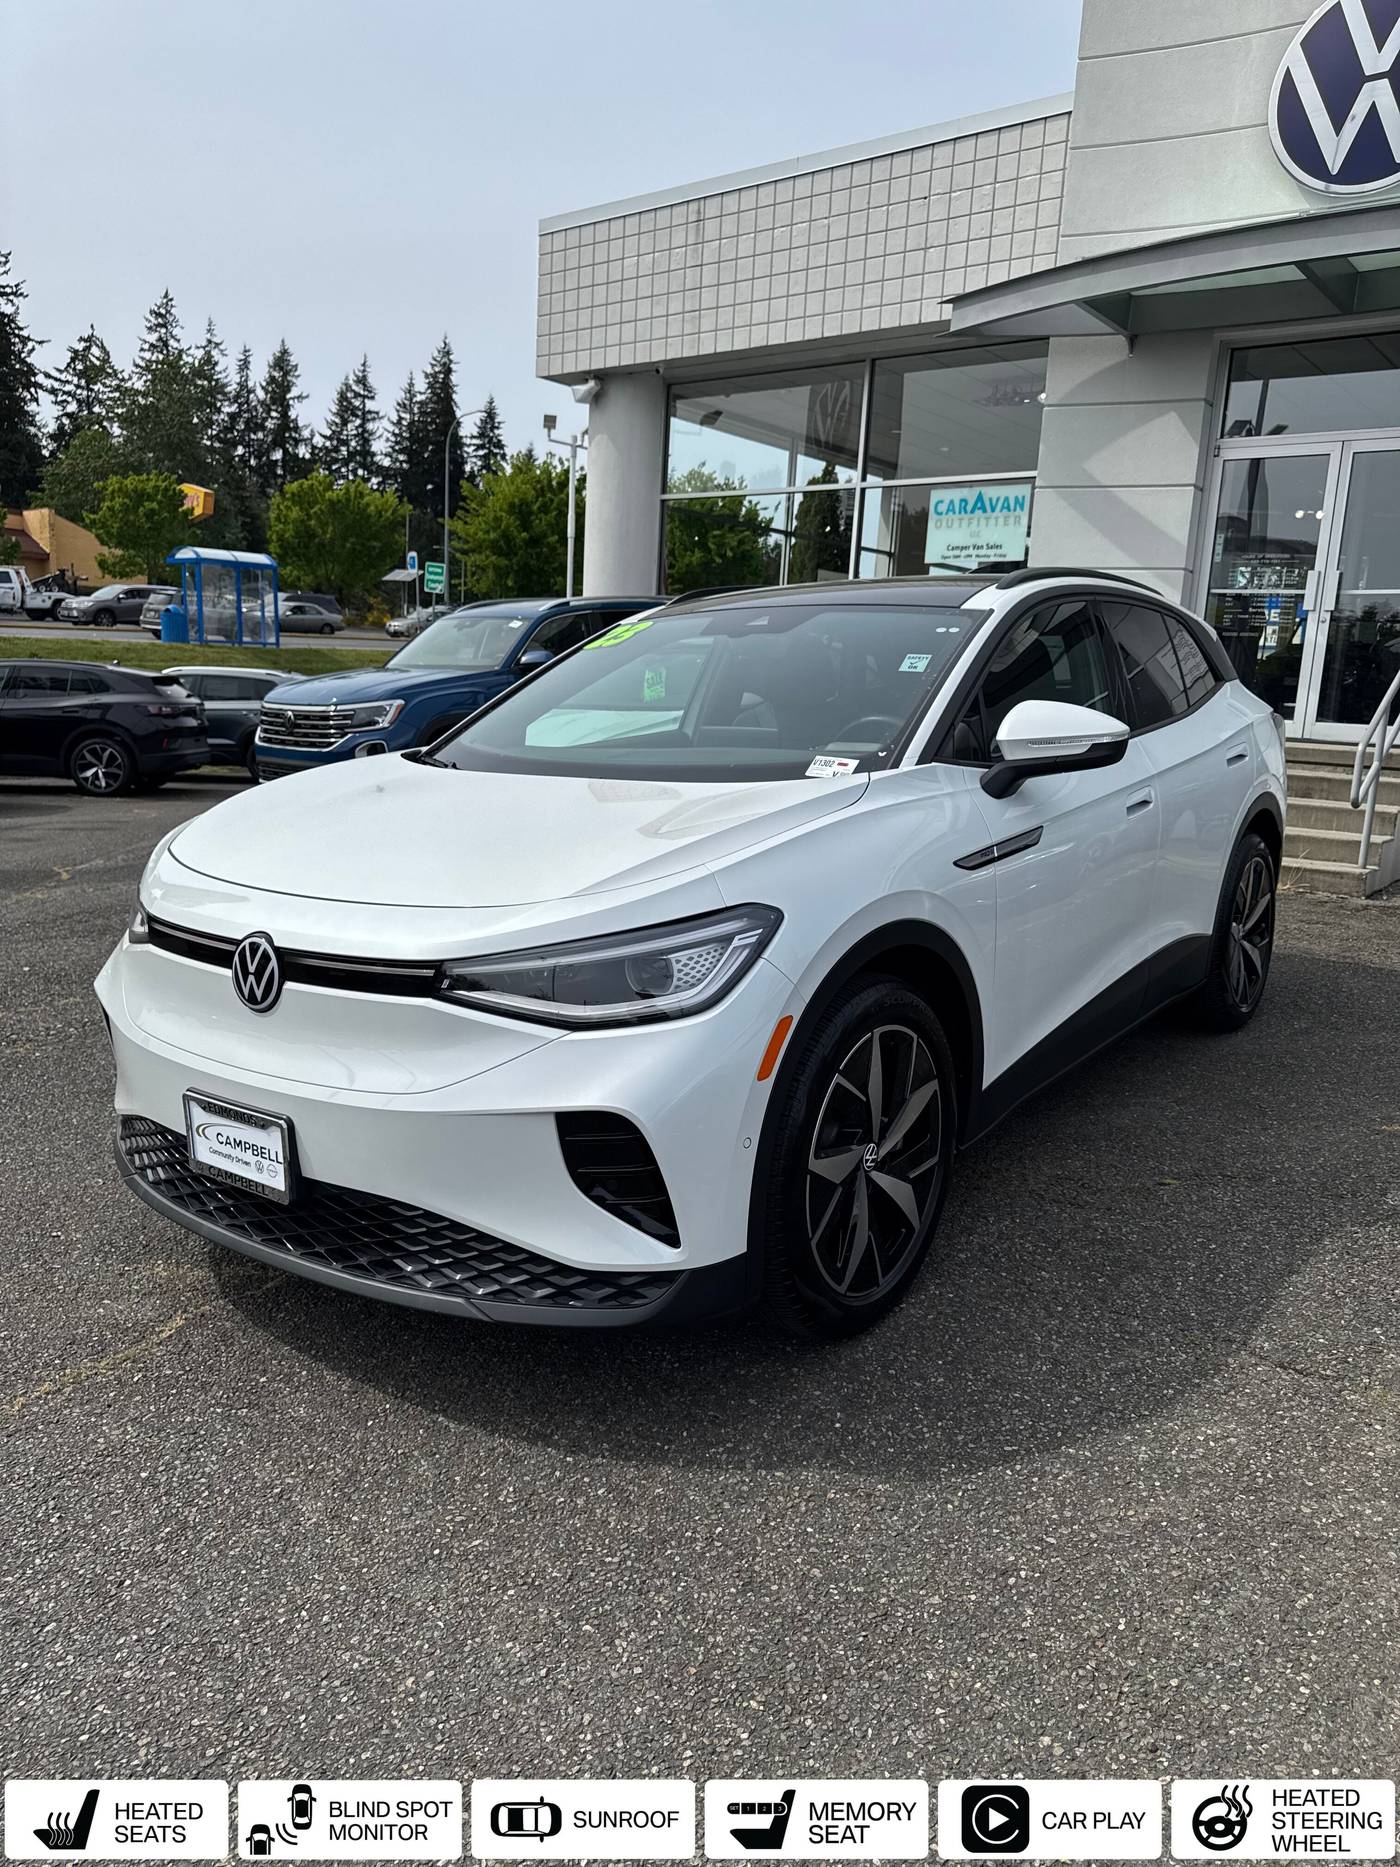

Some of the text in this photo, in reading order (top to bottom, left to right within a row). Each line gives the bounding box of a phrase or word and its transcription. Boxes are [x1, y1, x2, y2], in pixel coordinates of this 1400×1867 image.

[934, 490, 1026, 516] CARAVAN
[934, 515, 1022, 530] OUTFITTER
[946, 544, 971, 552] Camper
[972, 543, 984, 551] Van
[813, 758, 836, 768] V1302
[207, 1102, 258, 1127] EDMONDS
[208, 1146, 252, 1168] Community Driven
[216, 1132, 283, 1165] CAMPBELL
[208, 1167, 269, 1197] CAMPBELL
